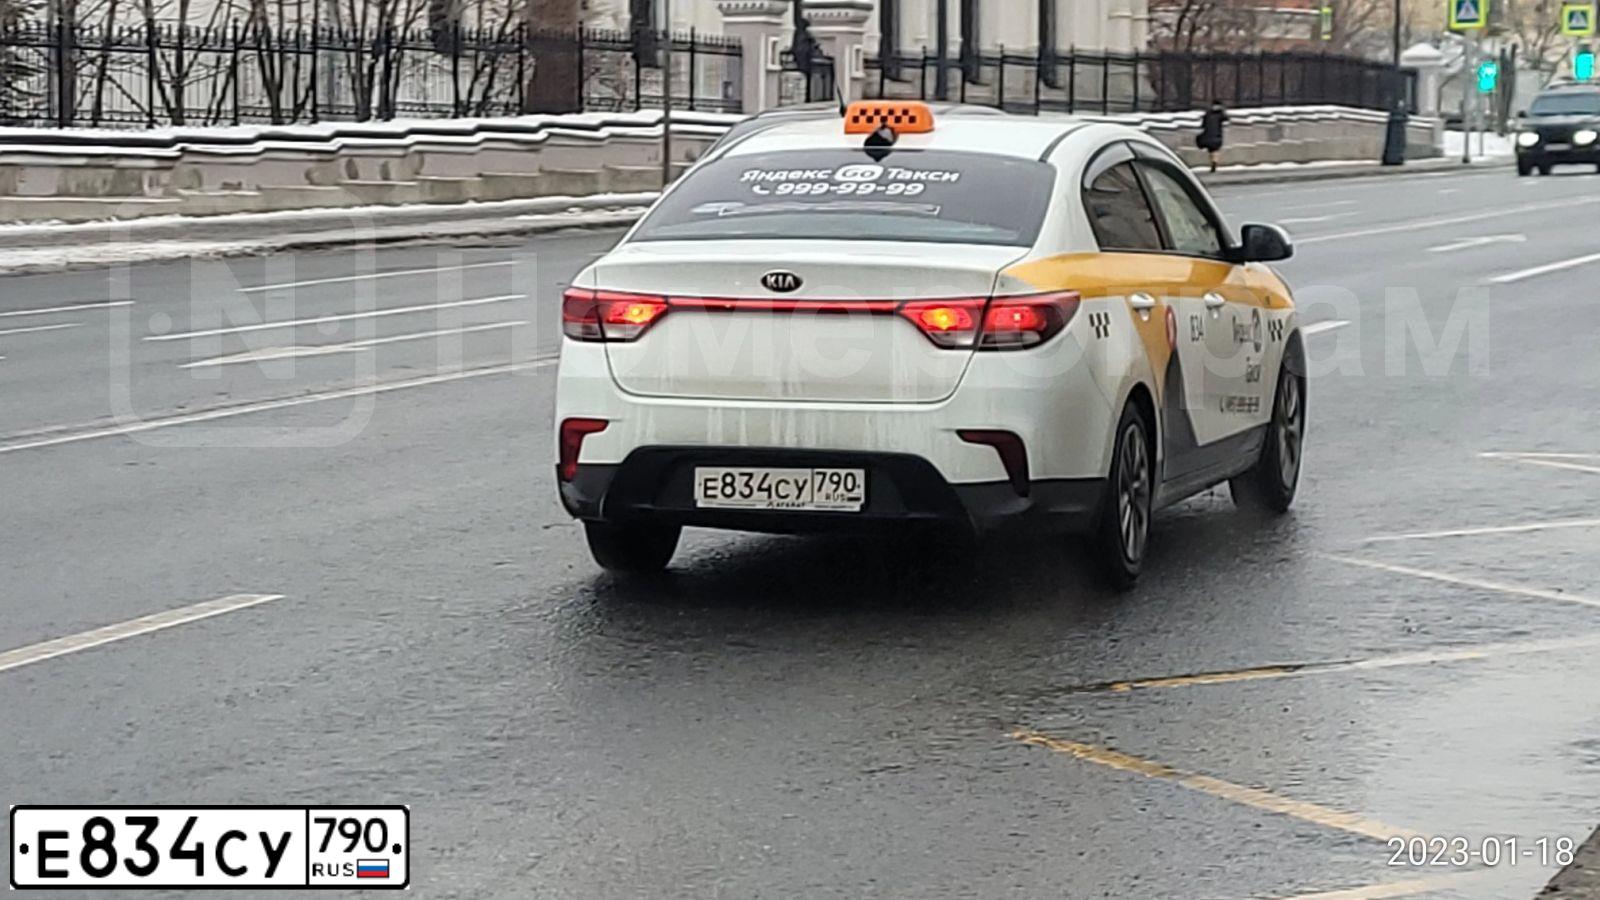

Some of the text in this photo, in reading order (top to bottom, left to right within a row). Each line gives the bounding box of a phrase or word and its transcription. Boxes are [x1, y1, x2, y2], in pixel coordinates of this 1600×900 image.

[740, 169, 832, 182] Яндекс
[887, 168, 960, 182] Такси
[775, 182, 925, 195] 999-99-99
[766, 274, 795, 288] KIA
[815, 471, 857, 493] 790
[824, 493, 846, 502] RUS
